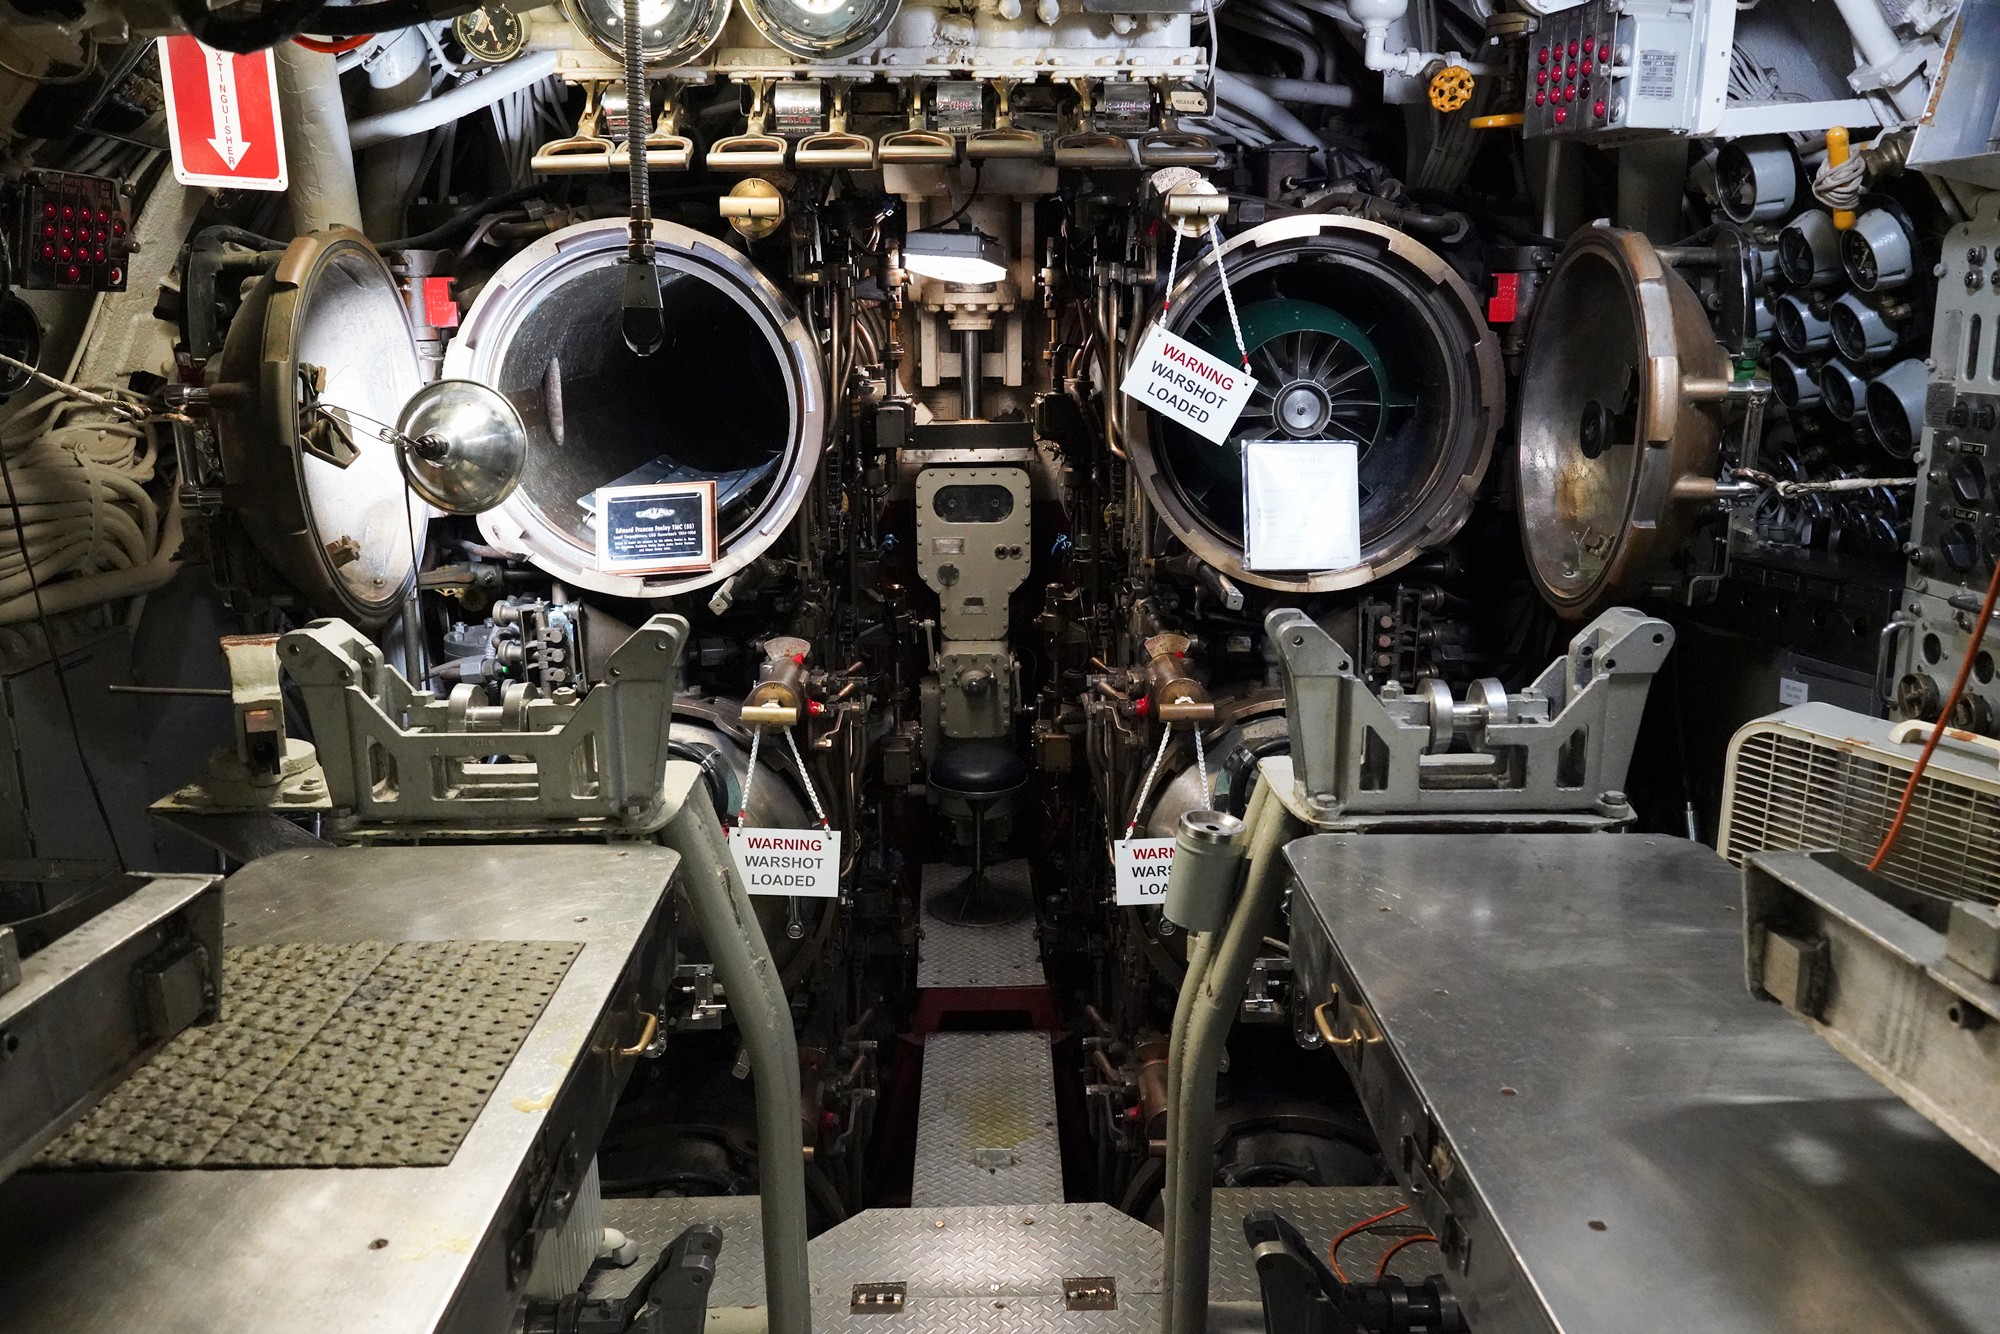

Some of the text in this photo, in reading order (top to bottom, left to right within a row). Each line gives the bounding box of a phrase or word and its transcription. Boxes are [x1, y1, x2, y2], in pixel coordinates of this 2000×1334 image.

[215, 52, 235, 165] XTINGUISHER
[788, 105, 810, 113] TUBE
[1163, 343, 1234, 391] WARNING
[1151, 360, 1228, 409] WARSHOT
[1147, 382, 1209, 423] LOADED
[747, 837, 822, 851] WARNING
[1133, 847, 1175, 860] WARN
[745, 855, 824, 869] WARSHOT
[751, 873, 816, 887] LOADED
[1139, 883, 1168, 895] LOA
